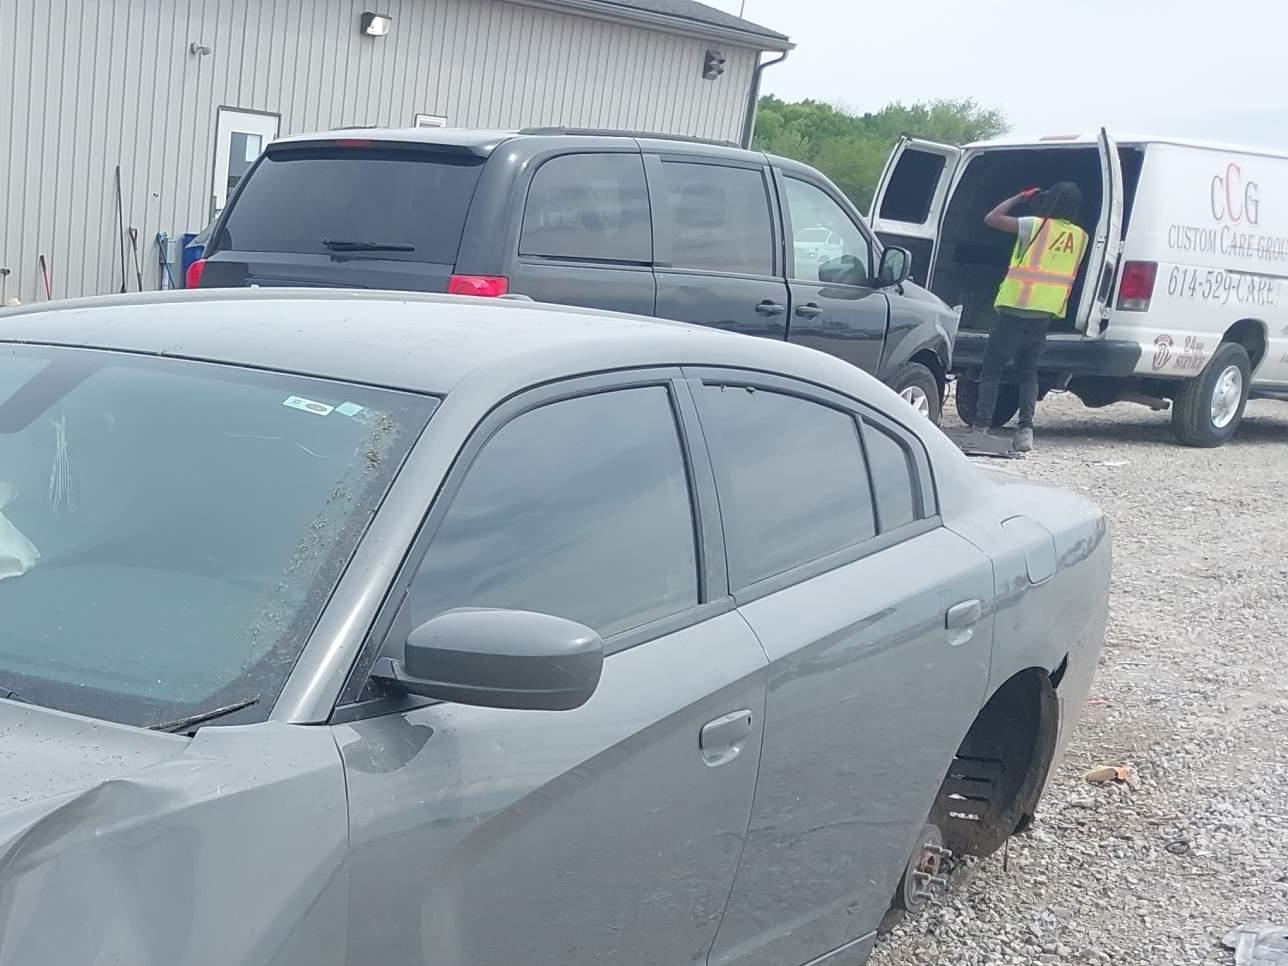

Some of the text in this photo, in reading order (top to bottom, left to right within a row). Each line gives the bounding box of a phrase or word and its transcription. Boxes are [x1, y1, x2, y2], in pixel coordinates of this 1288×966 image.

[1210, 162, 1259, 225] CCG
[1168, 223, 1217, 254] CUSTOM
[1168, 266, 1274, 305] 614-529-CARE
